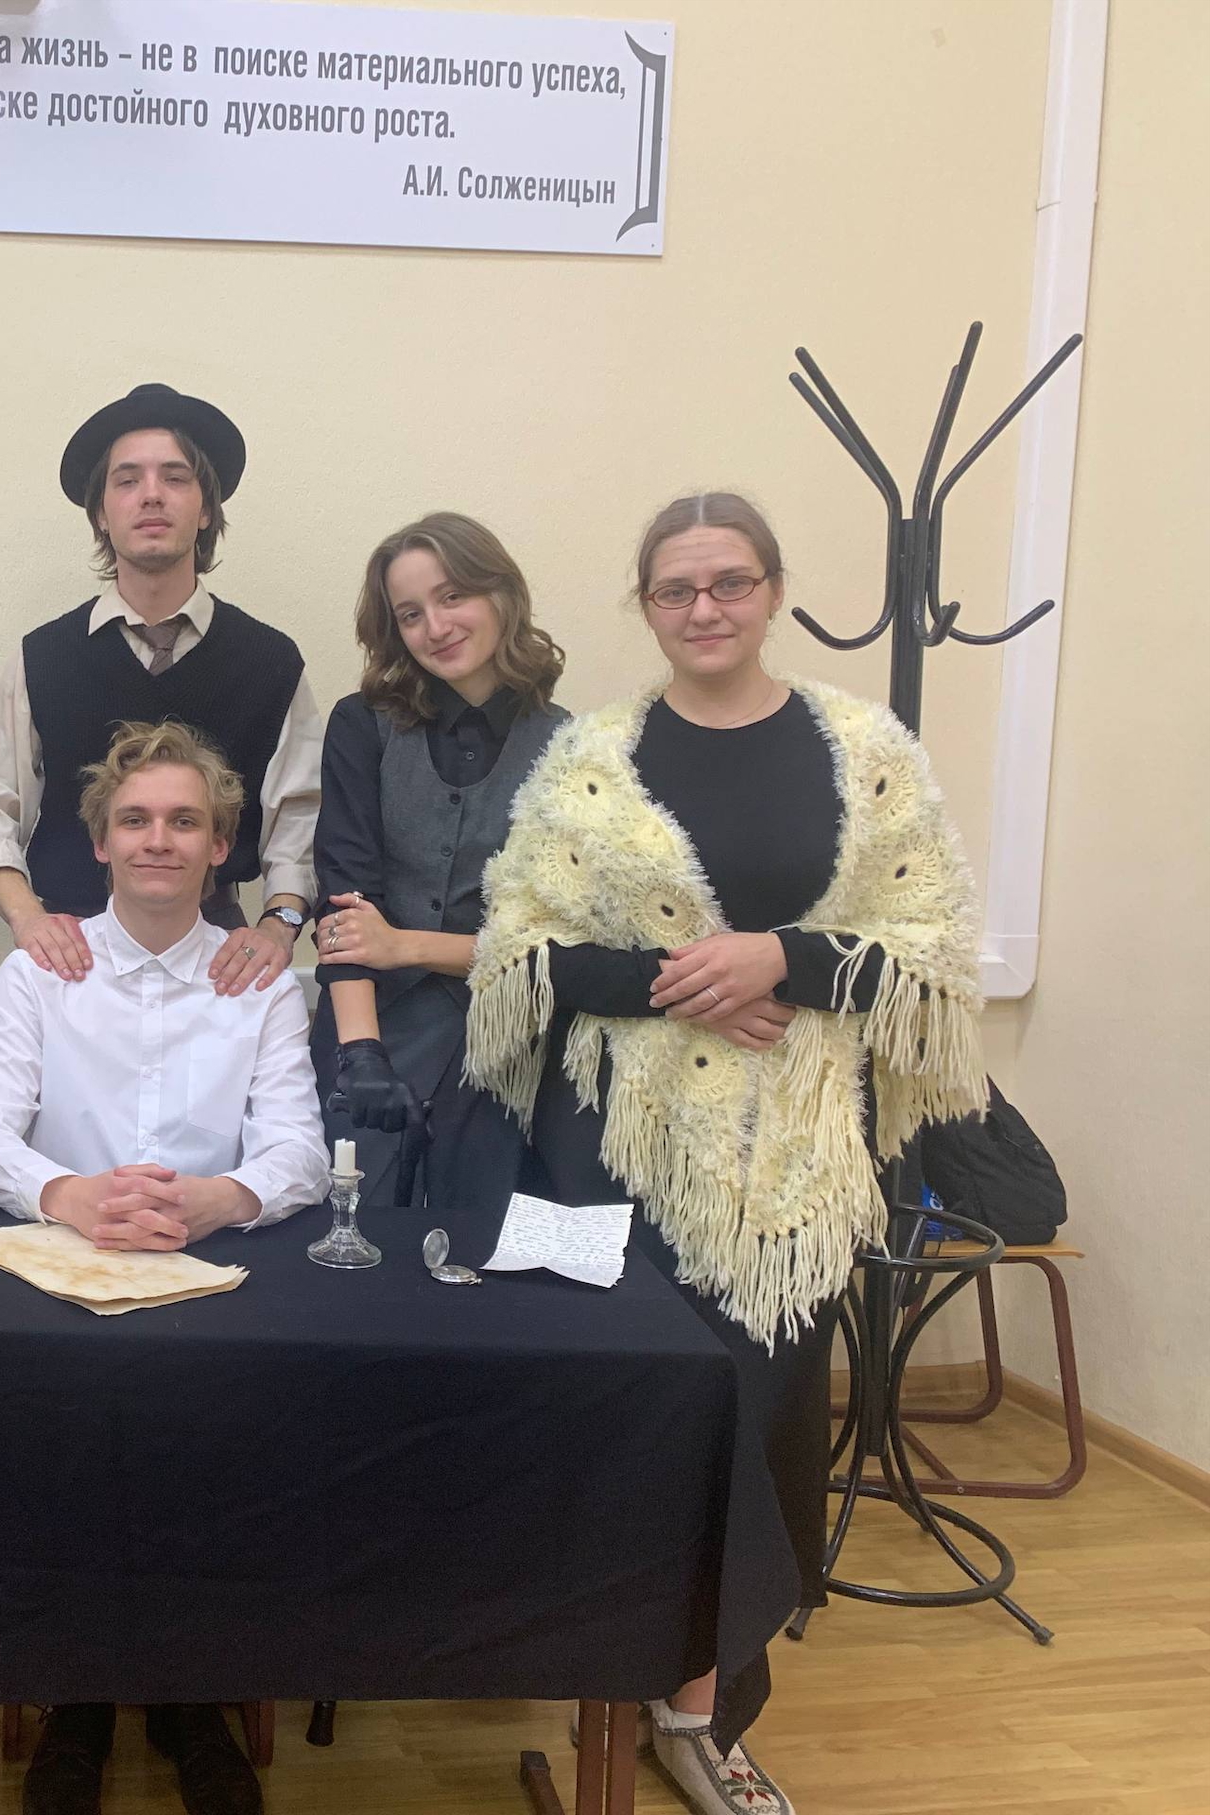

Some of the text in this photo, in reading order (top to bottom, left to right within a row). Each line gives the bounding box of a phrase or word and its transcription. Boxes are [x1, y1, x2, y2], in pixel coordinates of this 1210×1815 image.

[21, 36, 108, 68] жизнь
[142, 43, 173, 72] не
[183, 45, 198, 73] в
[214, 46, 308, 78] поиске
[317, 51, 522, 91] материального
[531, 62, 627, 100] успеха,
[47, 88, 209, 128] достойного
[224, 100, 365, 138] духовного
[374, 107, 456, 143] роста.
[402, 164, 615, 207] А.И. Солженицын
